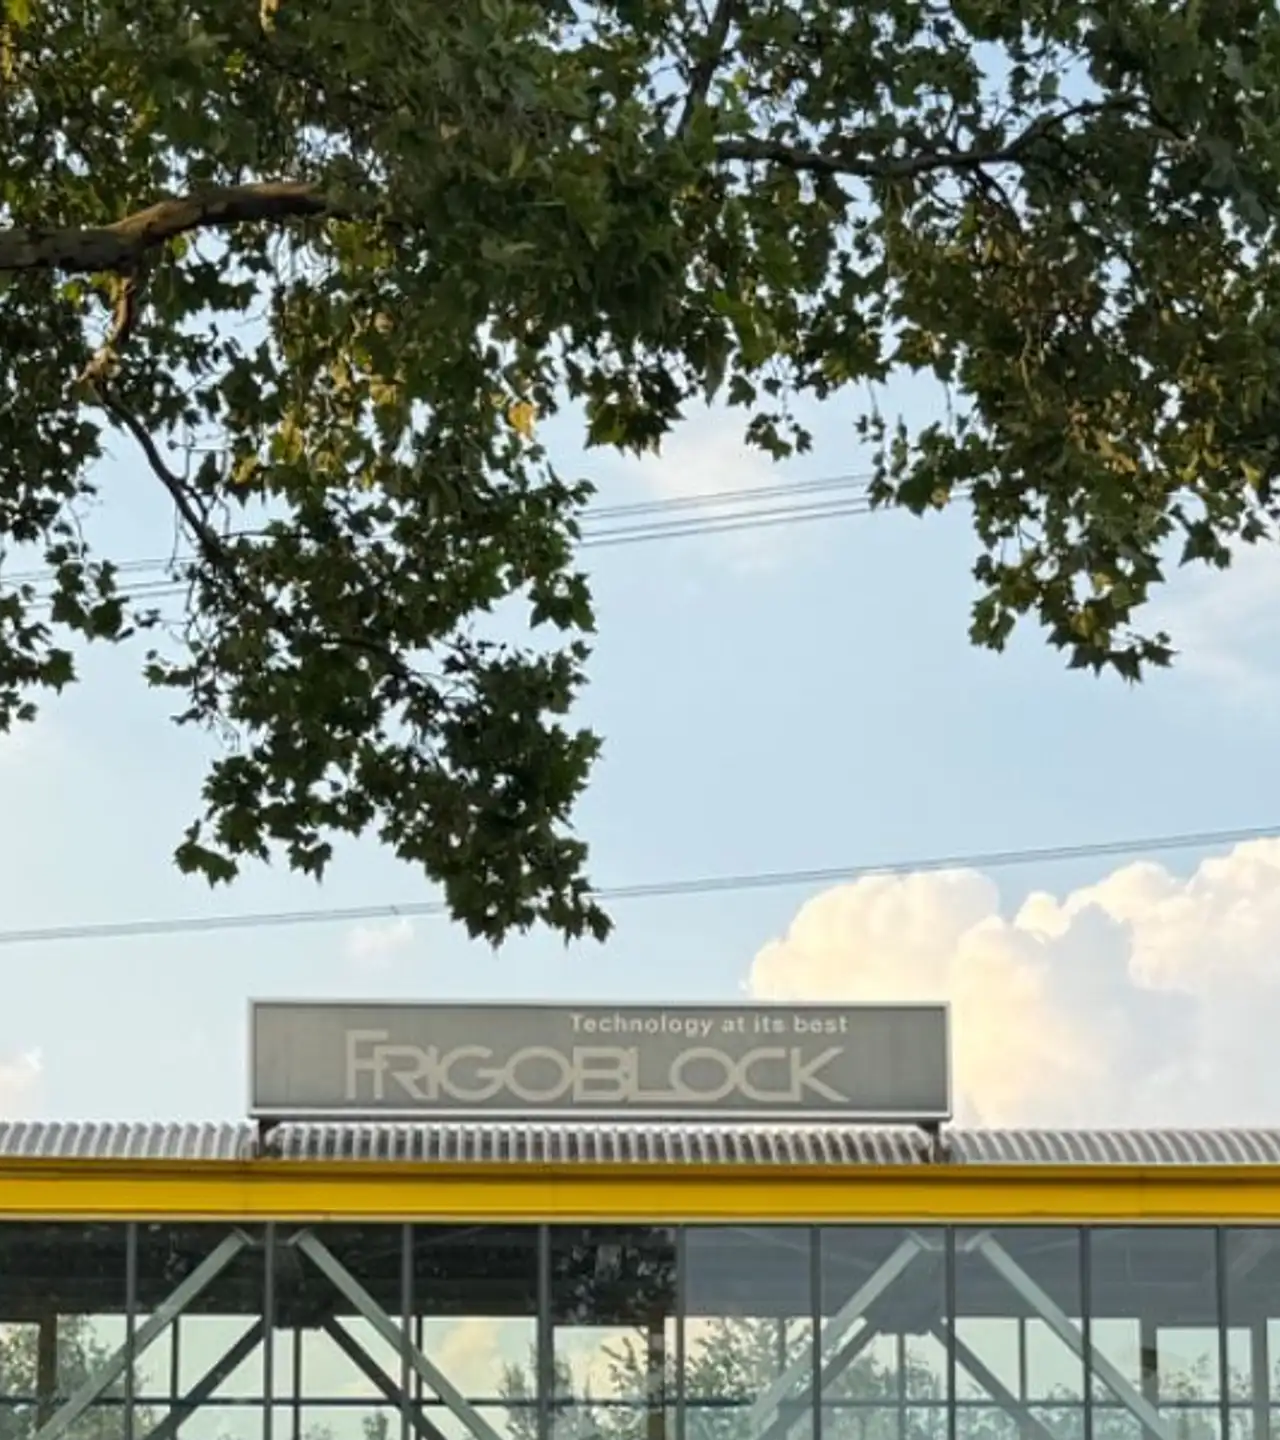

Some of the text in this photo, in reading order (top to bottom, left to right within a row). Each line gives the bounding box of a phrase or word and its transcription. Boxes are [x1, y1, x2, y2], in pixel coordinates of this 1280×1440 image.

[570, 1013, 849, 1038] Technology at its best
[345, 1029, 851, 1103] FRIGOBLOCK
